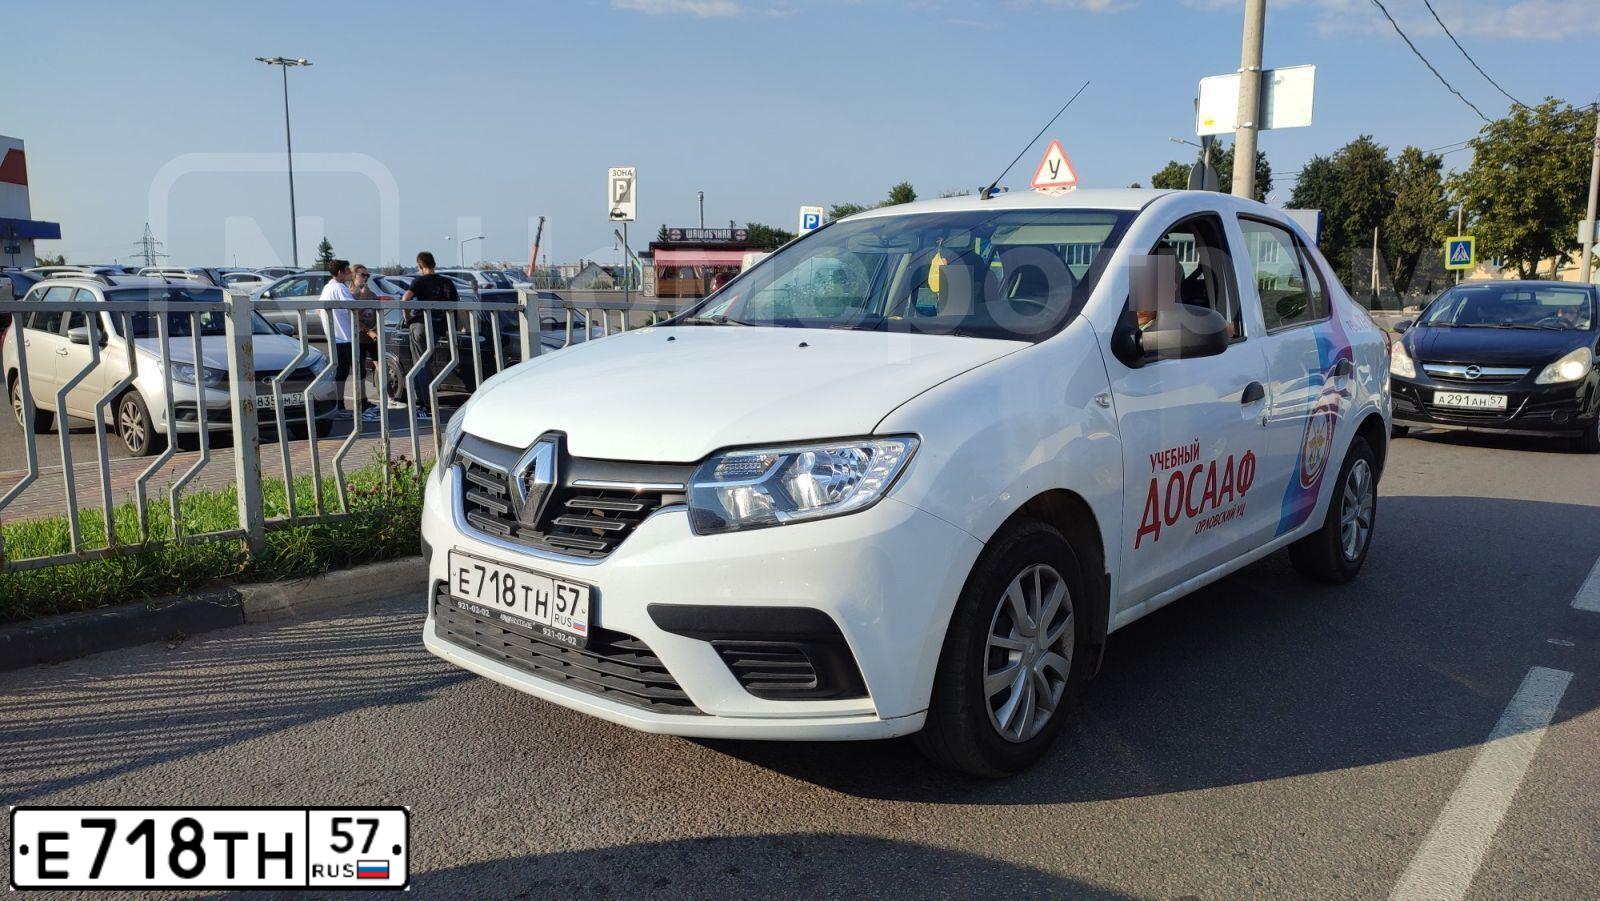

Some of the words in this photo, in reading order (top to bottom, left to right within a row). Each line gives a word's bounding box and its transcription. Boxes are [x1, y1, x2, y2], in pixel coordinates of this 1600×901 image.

[612, 169, 633, 177] ЗОНА
[1438, 394, 1487, 407] А291АН
[1490, 396, 1503, 404] 57
[1150, 436, 1200, 473] УЧЕБНЫЙ
[1134, 450, 1256, 549] ДОСААФ
[1194, 504, 1236, 534] ОРЛОВСКИЙ
[459, 564, 549, 618] Е718ТН
[556, 584, 580, 616] 57
[457, 601, 490, 617] 921-02-02
[542, 628, 577, 645] 921-02-02
[554, 613, 572, 628] RUS
